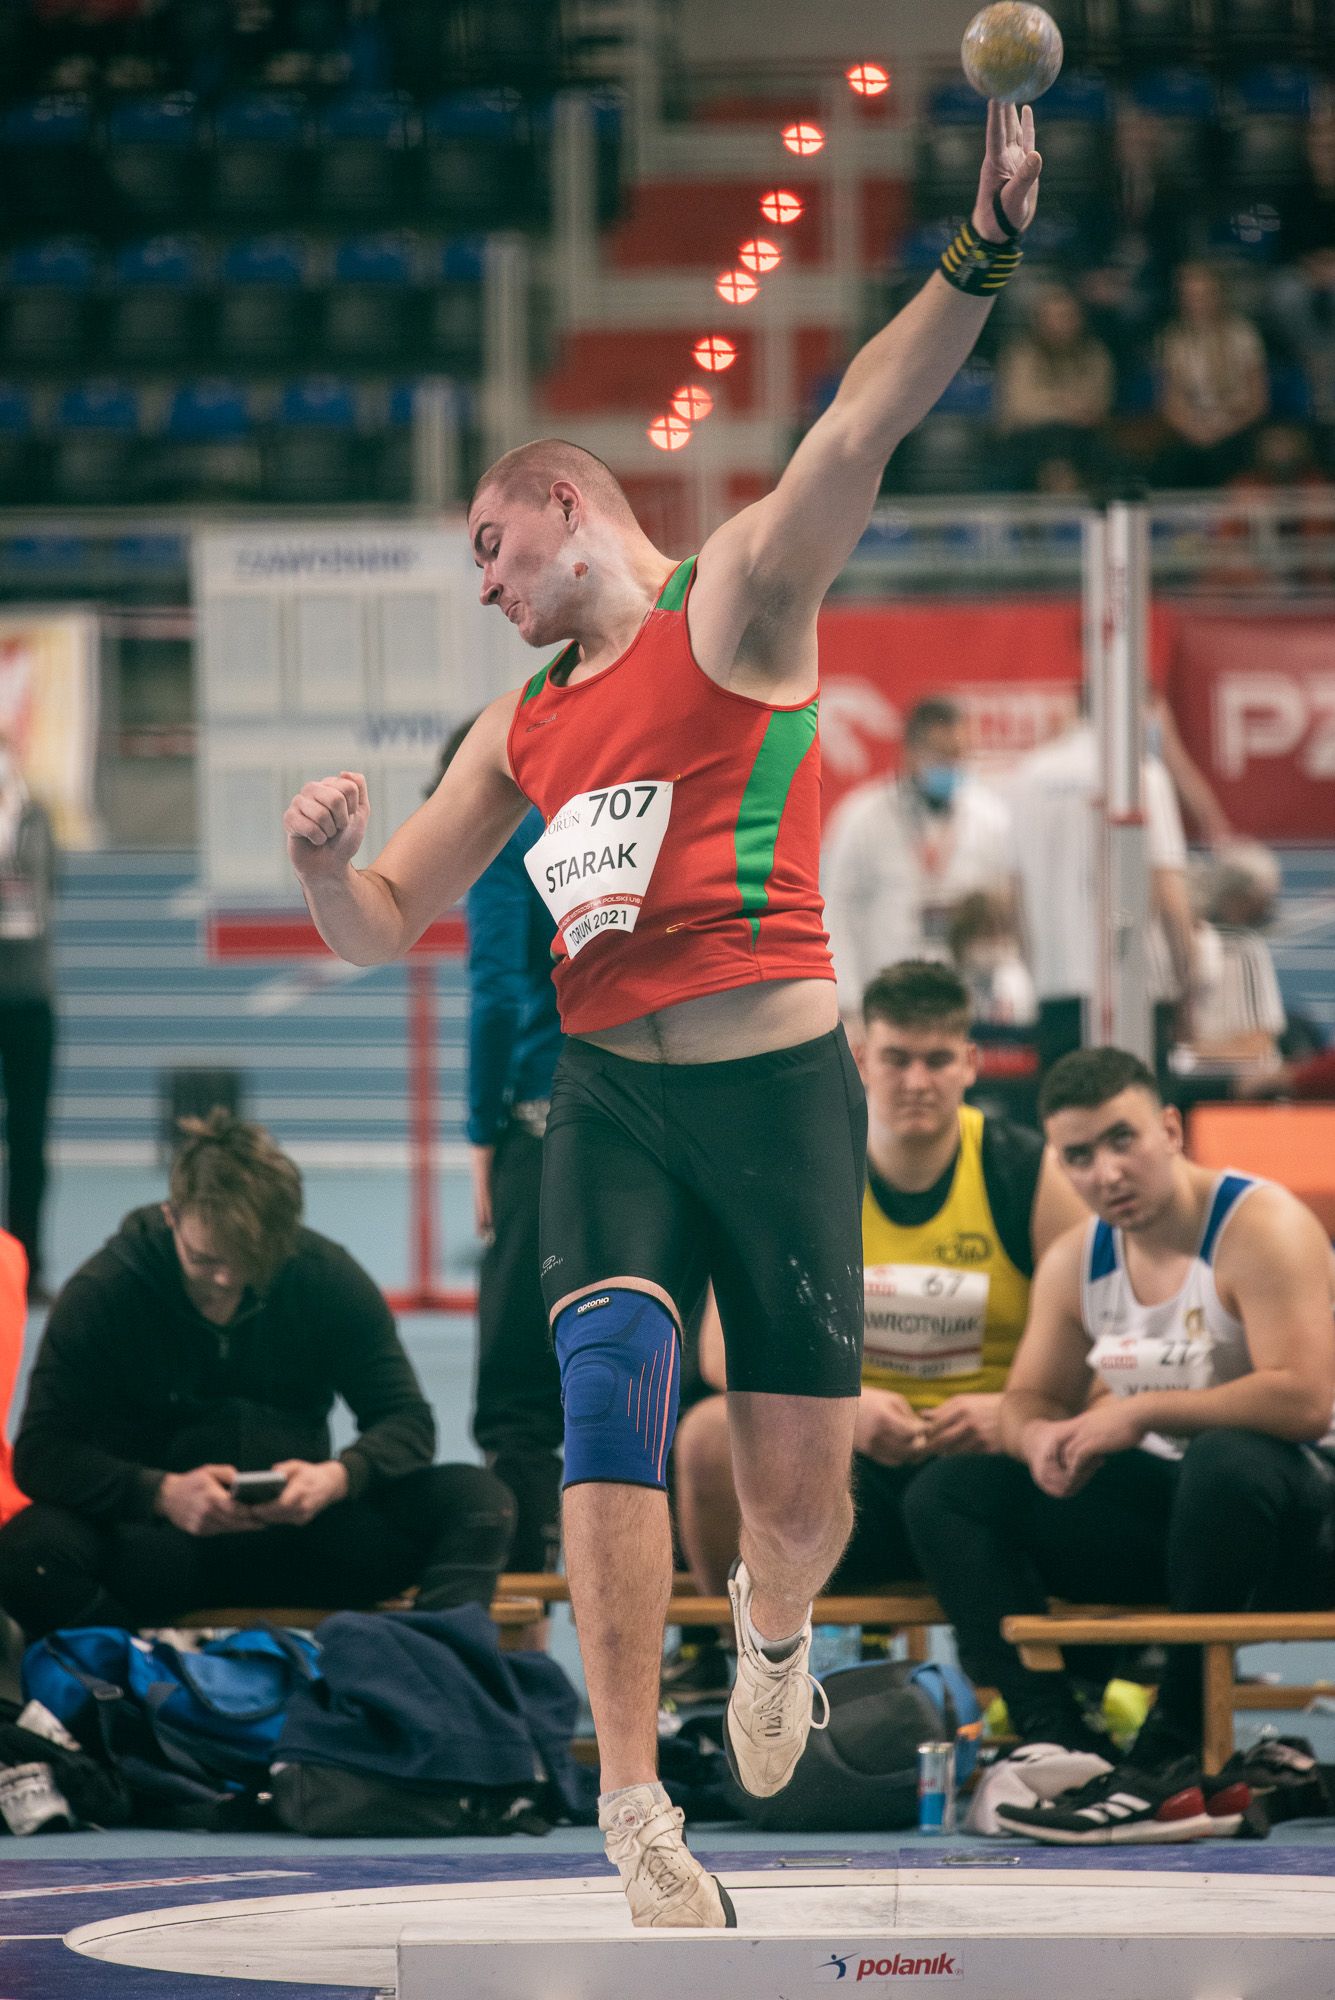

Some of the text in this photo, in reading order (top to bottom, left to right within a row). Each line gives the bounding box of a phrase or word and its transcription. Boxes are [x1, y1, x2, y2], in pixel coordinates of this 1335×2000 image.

[588, 786, 658, 827] 707
[546, 842, 638, 893] STARAK
[602, 895, 628, 904] POLSKI
[569, 914, 592, 947] TORUŃ
[593, 910, 627, 930] 2021
[923, 1272, 968, 1298] 67
[577, 1296, 610, 1314] aptonia
[856, 1952, 956, 1982] polanik
